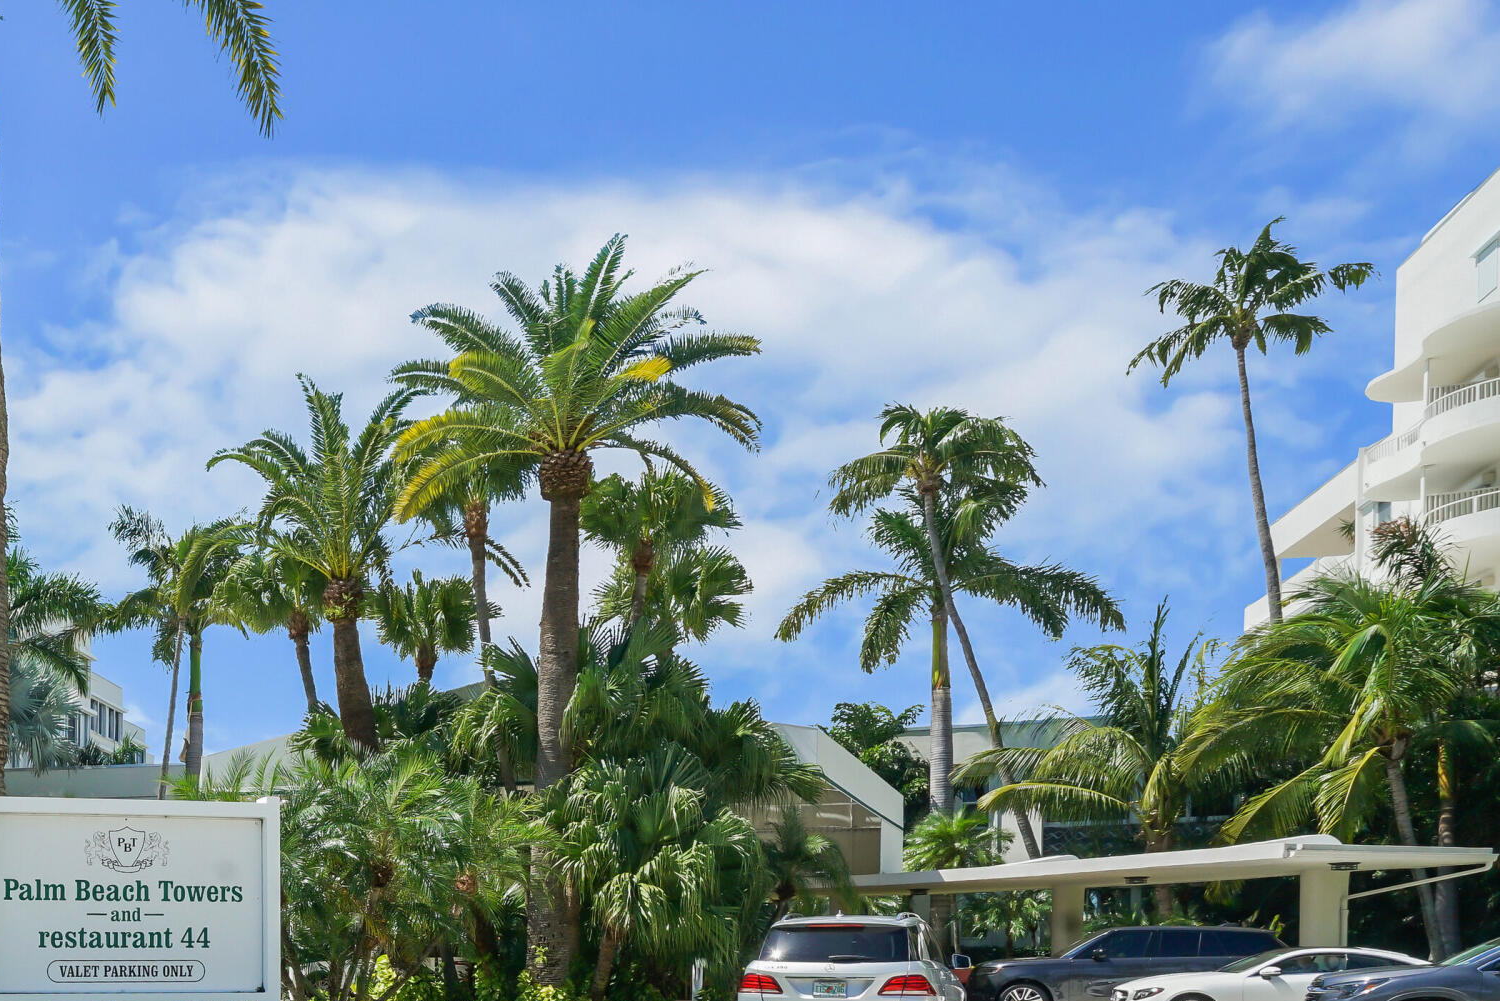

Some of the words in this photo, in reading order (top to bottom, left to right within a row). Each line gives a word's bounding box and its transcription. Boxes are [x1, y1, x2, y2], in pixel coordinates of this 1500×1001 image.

[3, 878, 67, 901] Palm
[74, 879, 151, 902] Beach
[158, 880, 243, 903] Towers
[110, 907, 142, 922] and
[38, 927, 174, 949] restaurant
[180, 926, 211, 949] 44
[59, 964, 100, 978] VALET
[104, 964, 159, 978] PARKING
[162, 964, 194, 978] ONLY
